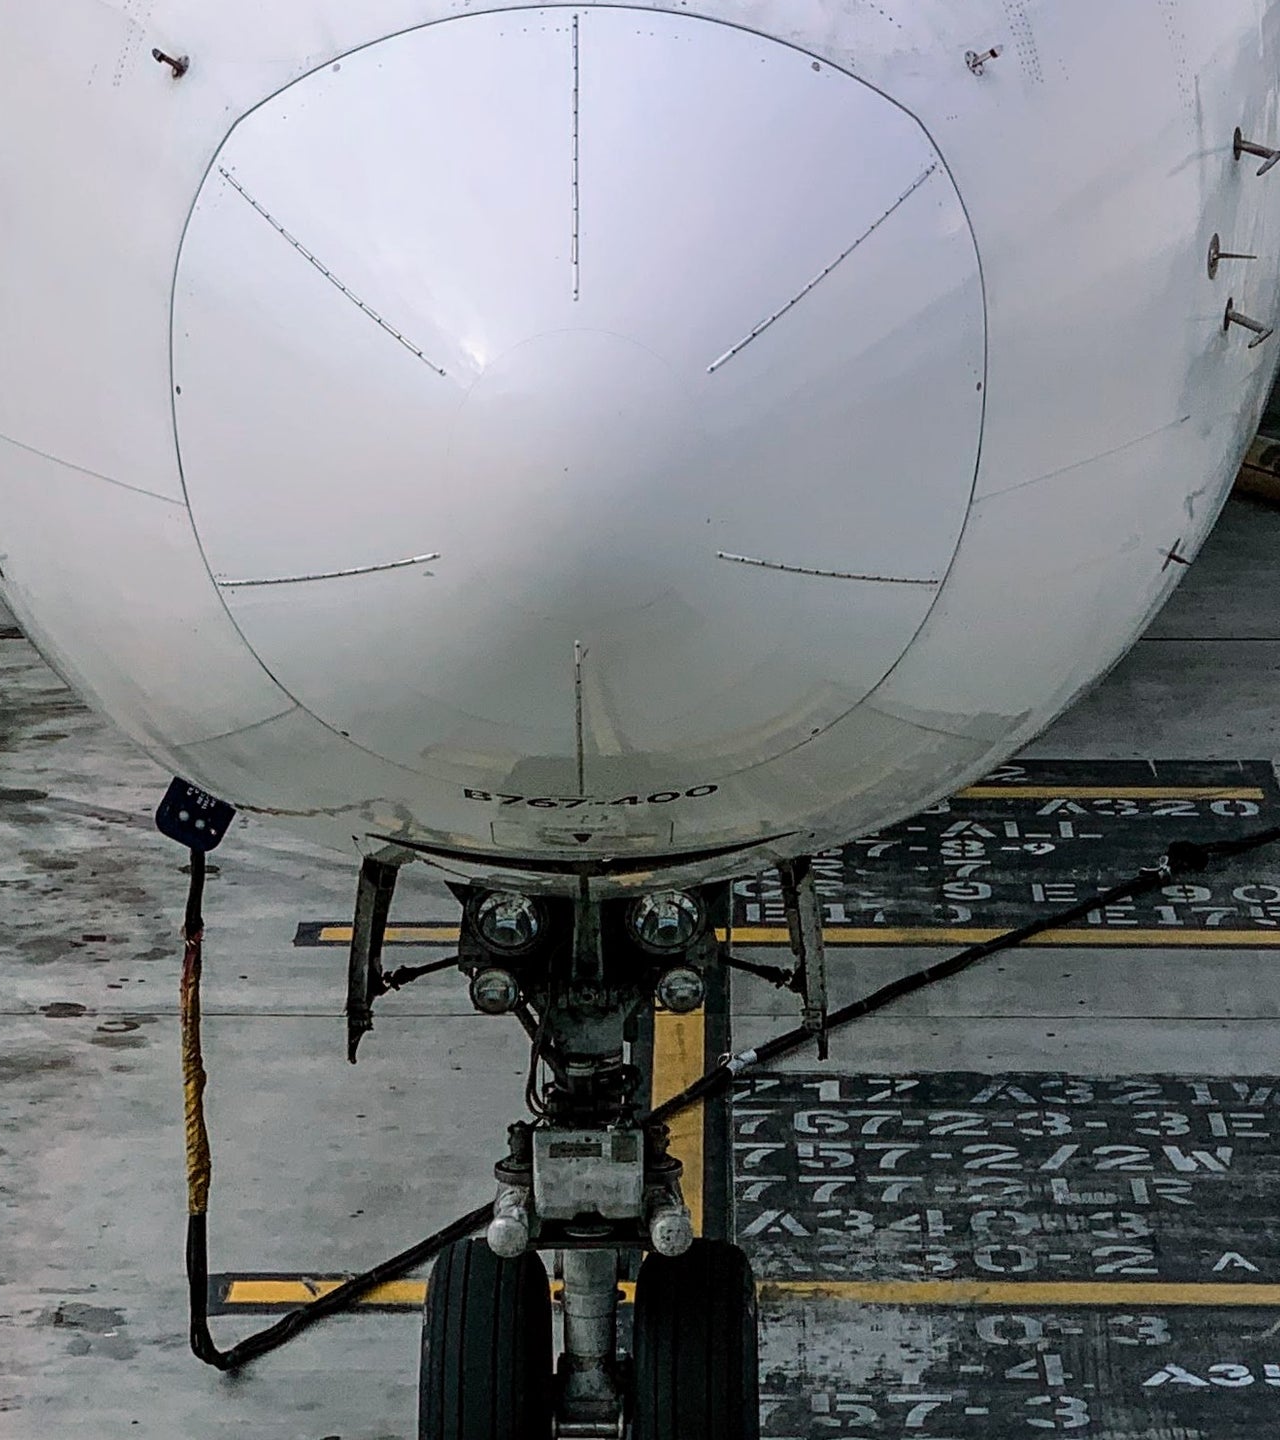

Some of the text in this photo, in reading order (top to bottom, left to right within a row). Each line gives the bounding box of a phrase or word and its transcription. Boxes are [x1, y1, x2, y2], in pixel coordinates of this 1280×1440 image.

[464, 784, 719, 809] B767-400
[1036, 799, 1260, 817] A320
[732, 1080, 920, 1102] 717
